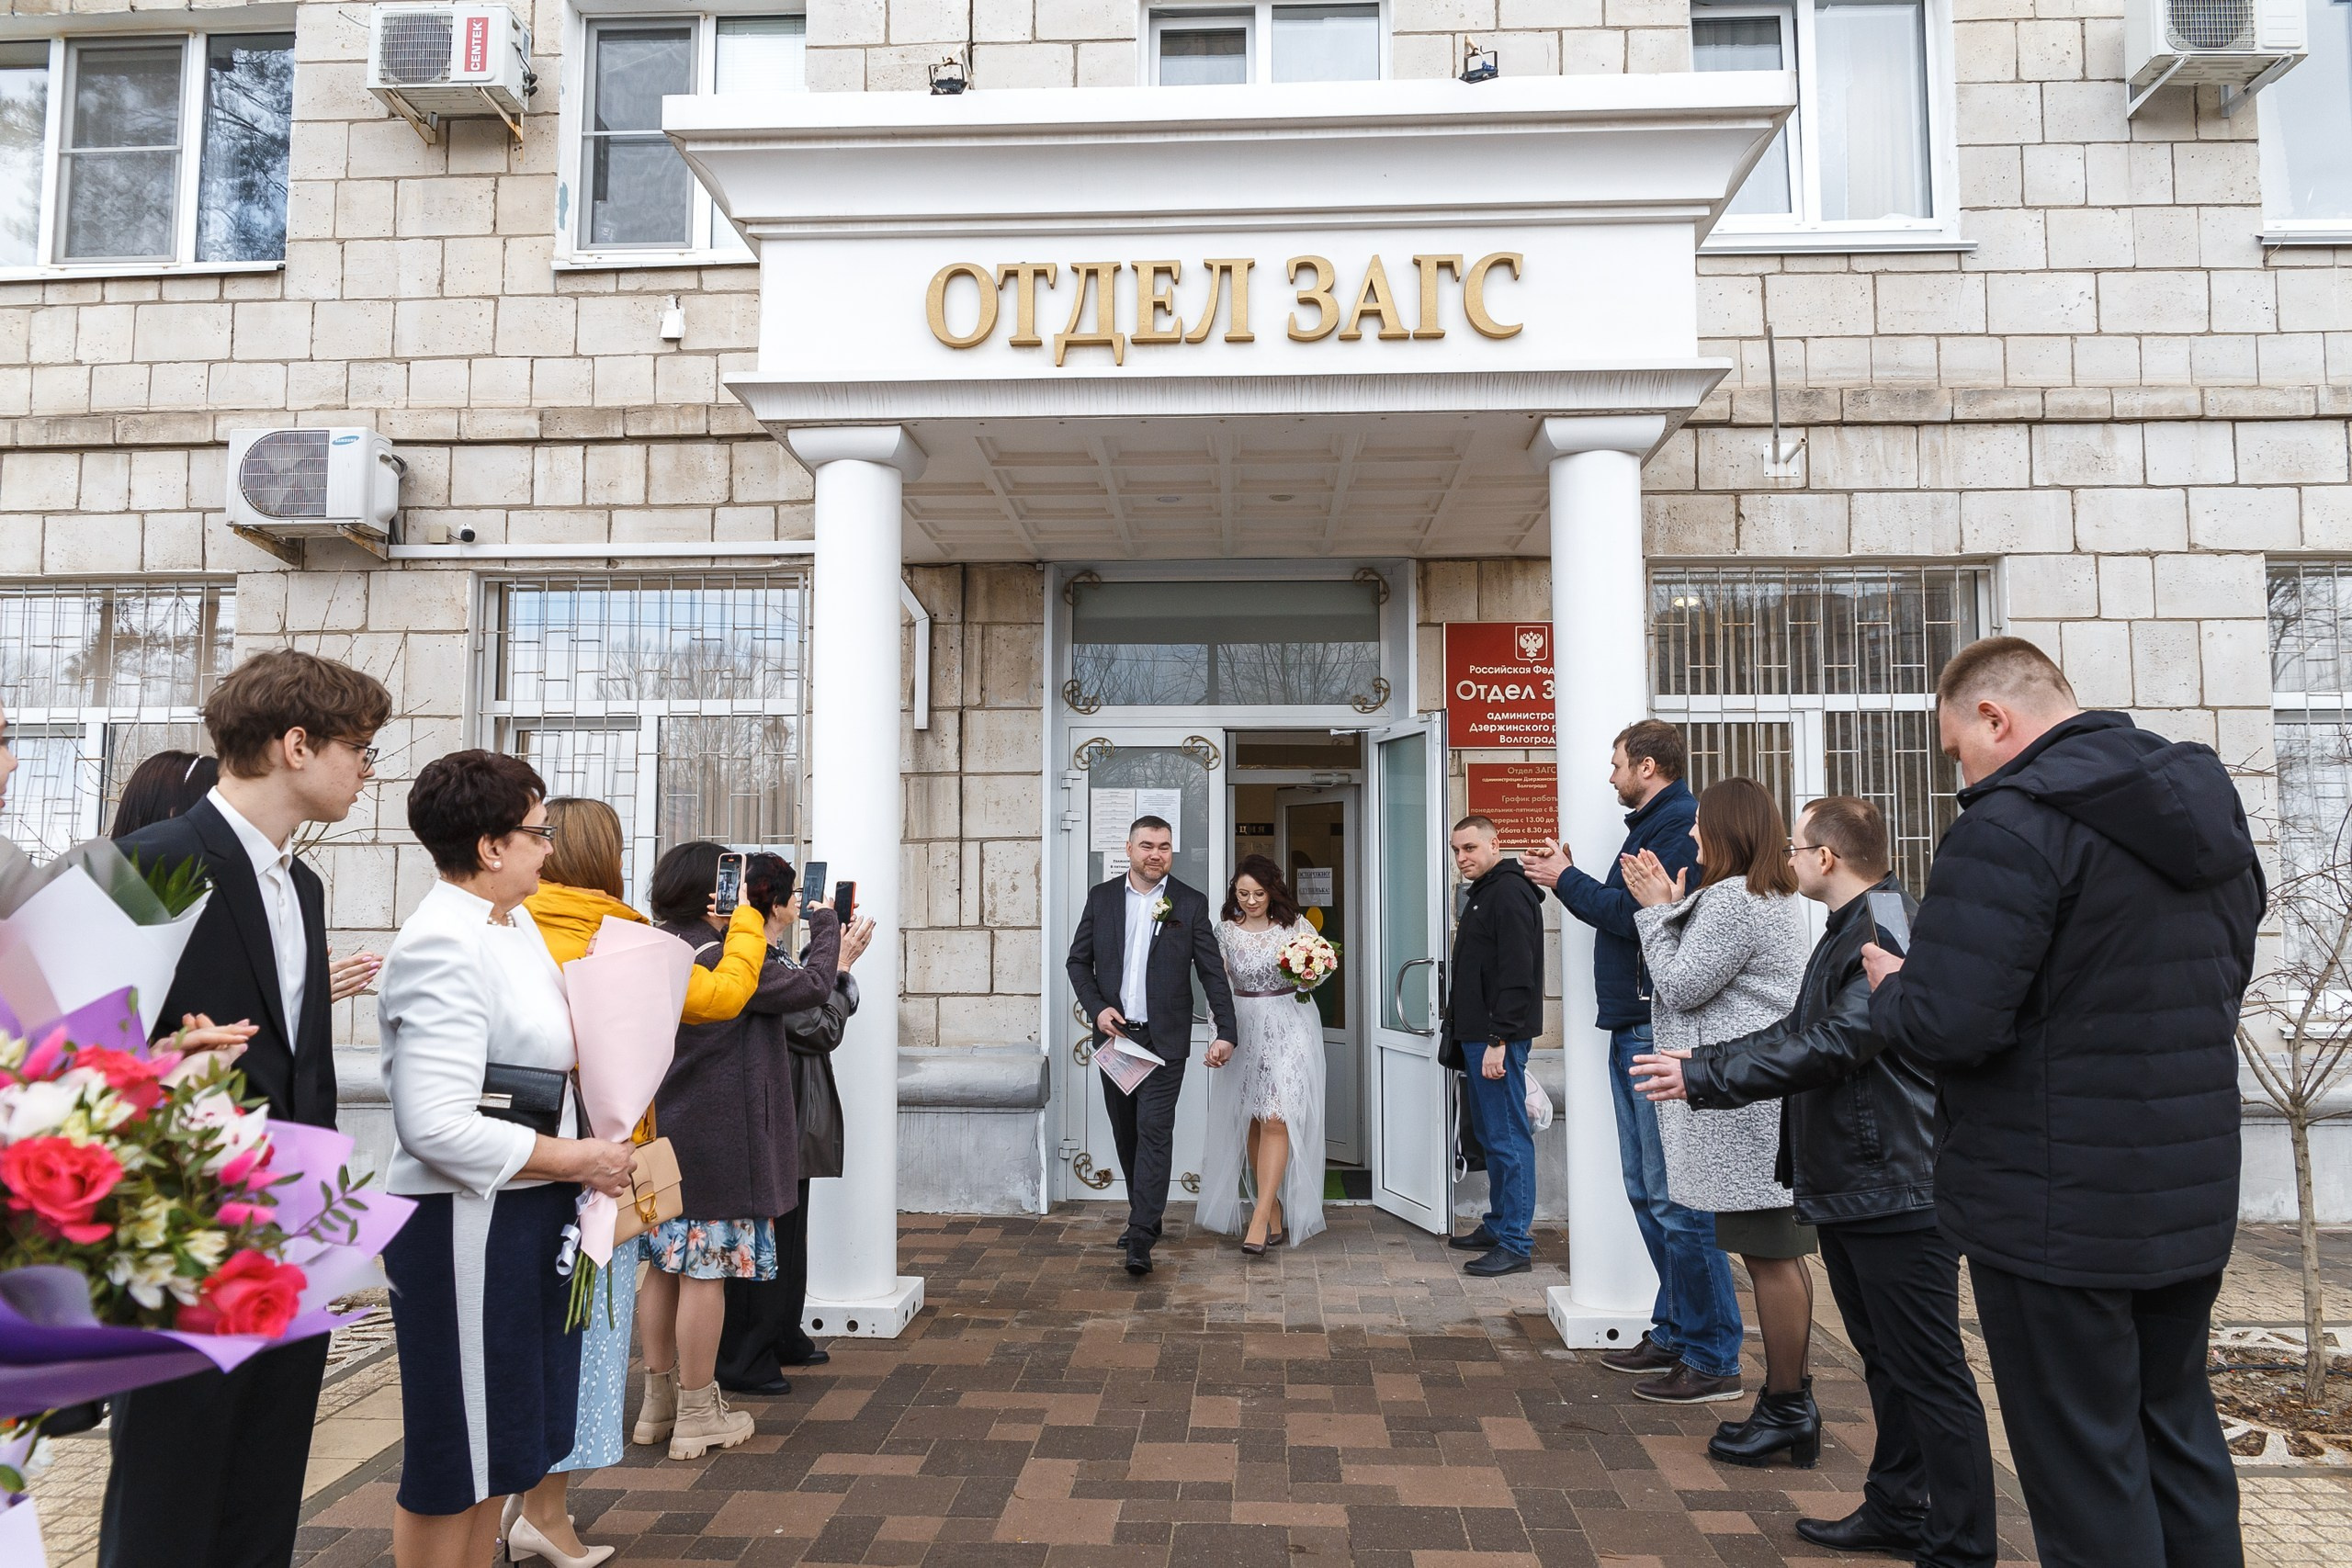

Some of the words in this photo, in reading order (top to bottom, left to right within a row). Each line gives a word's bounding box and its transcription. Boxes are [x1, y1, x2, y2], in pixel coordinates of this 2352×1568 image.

[470, 20, 483, 71] CENTEK
[925, 258, 1255, 367] ОТДЕЛ
[1286, 252, 1523, 342] ЗАГС
[1469, 665, 1532, 674] Российская
[1455, 680, 1536, 704] Отдел
[1487, 712, 1555, 721] администра
[1469, 723, 1550, 733] Дзержинского
[1499, 735, 1555, 745] Волгоград
[1507, 767, 1533, 775] Отдел
[1535, 766, 1556, 774] ЗАГС
[1501, 795, 1530, 804] График
